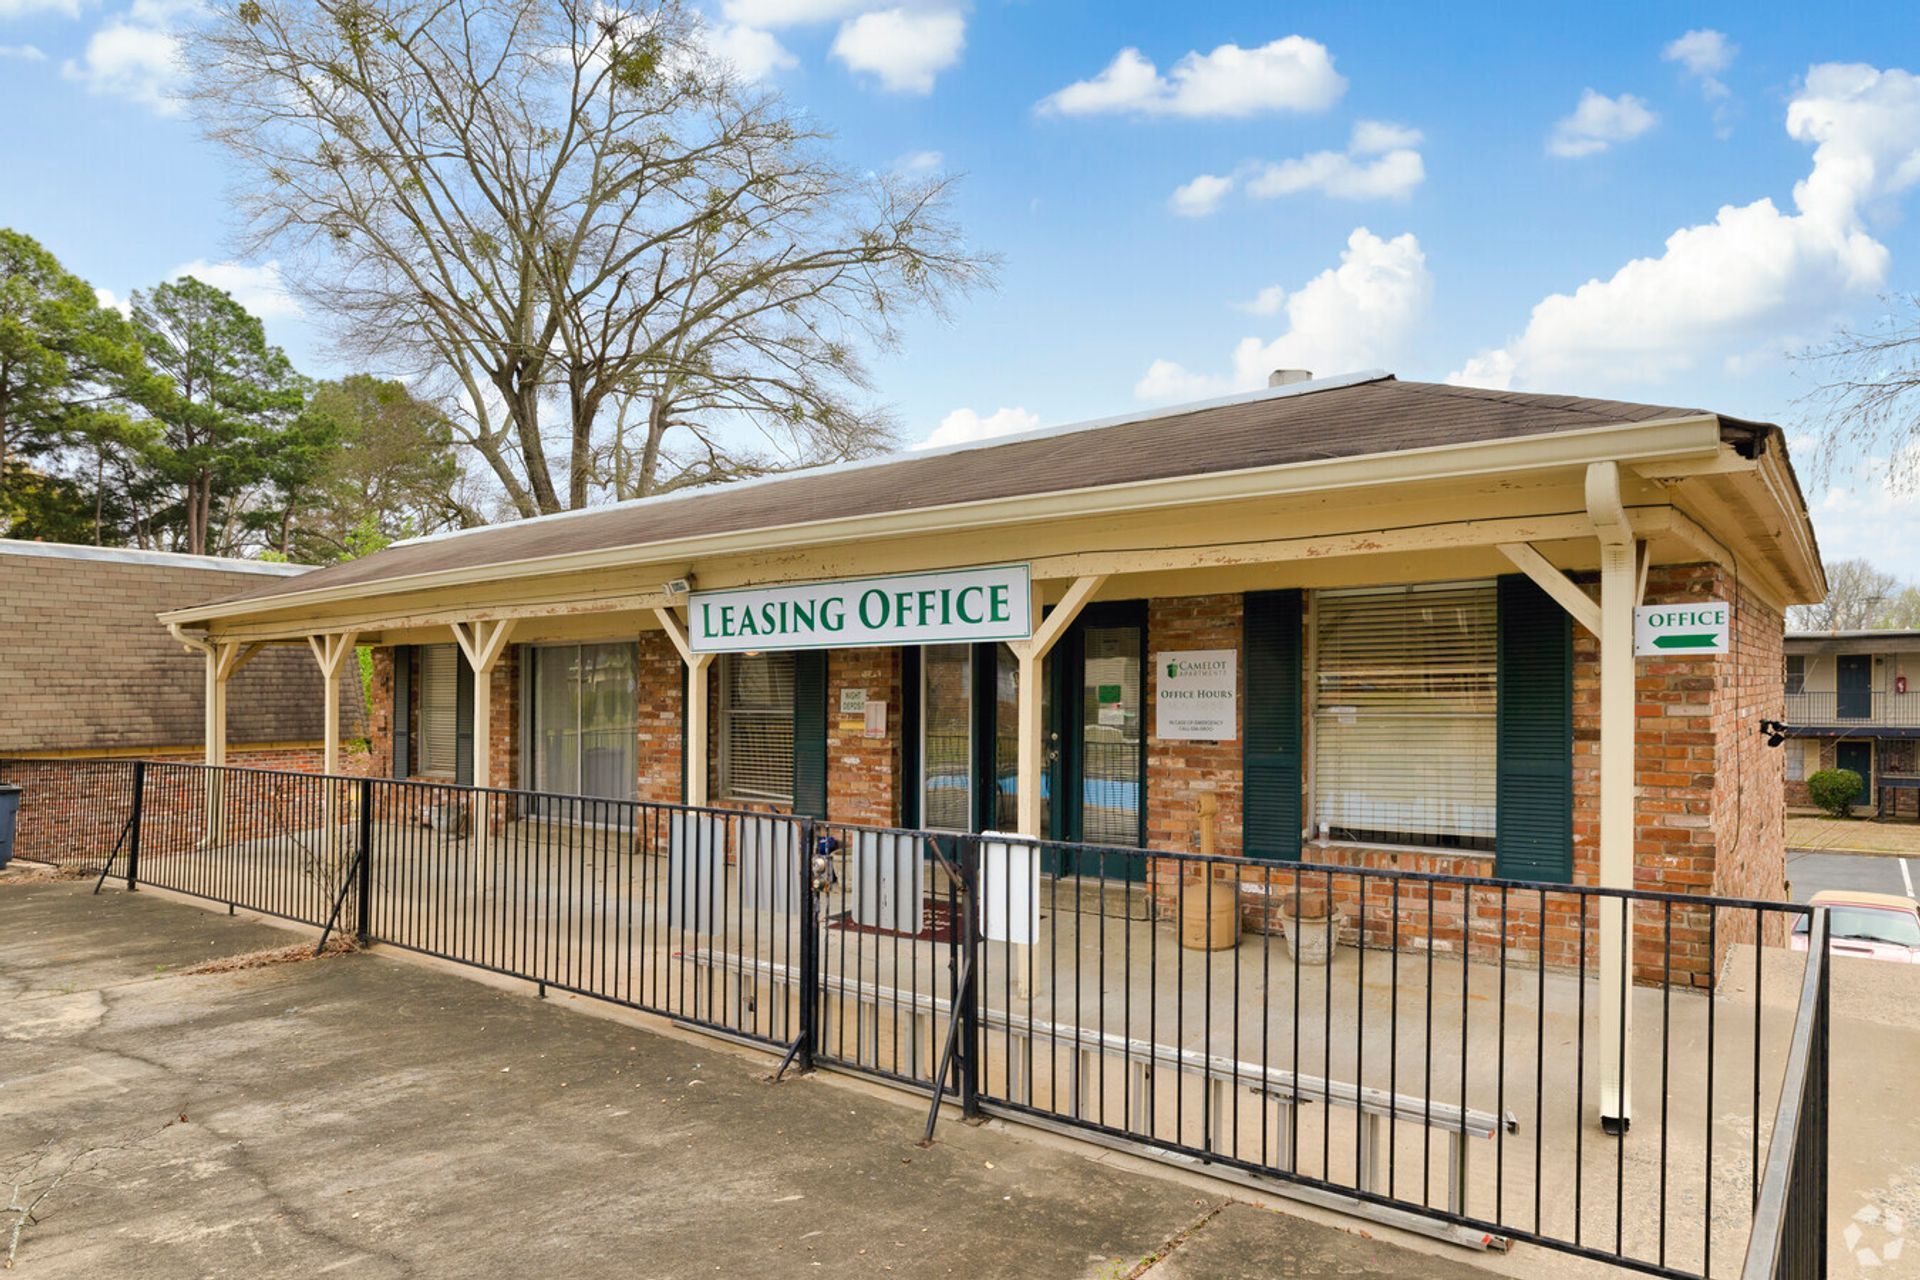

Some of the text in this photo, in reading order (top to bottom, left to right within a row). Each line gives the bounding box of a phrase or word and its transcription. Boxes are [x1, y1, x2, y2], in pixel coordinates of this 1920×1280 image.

[702, 584, 1011, 638] LEASING OFFICE
[1648, 610, 1725, 627] OFFICE
[1179, 661, 1226, 670] CAMELOT
[1160, 690, 1233, 699] OFFICE HOURS
